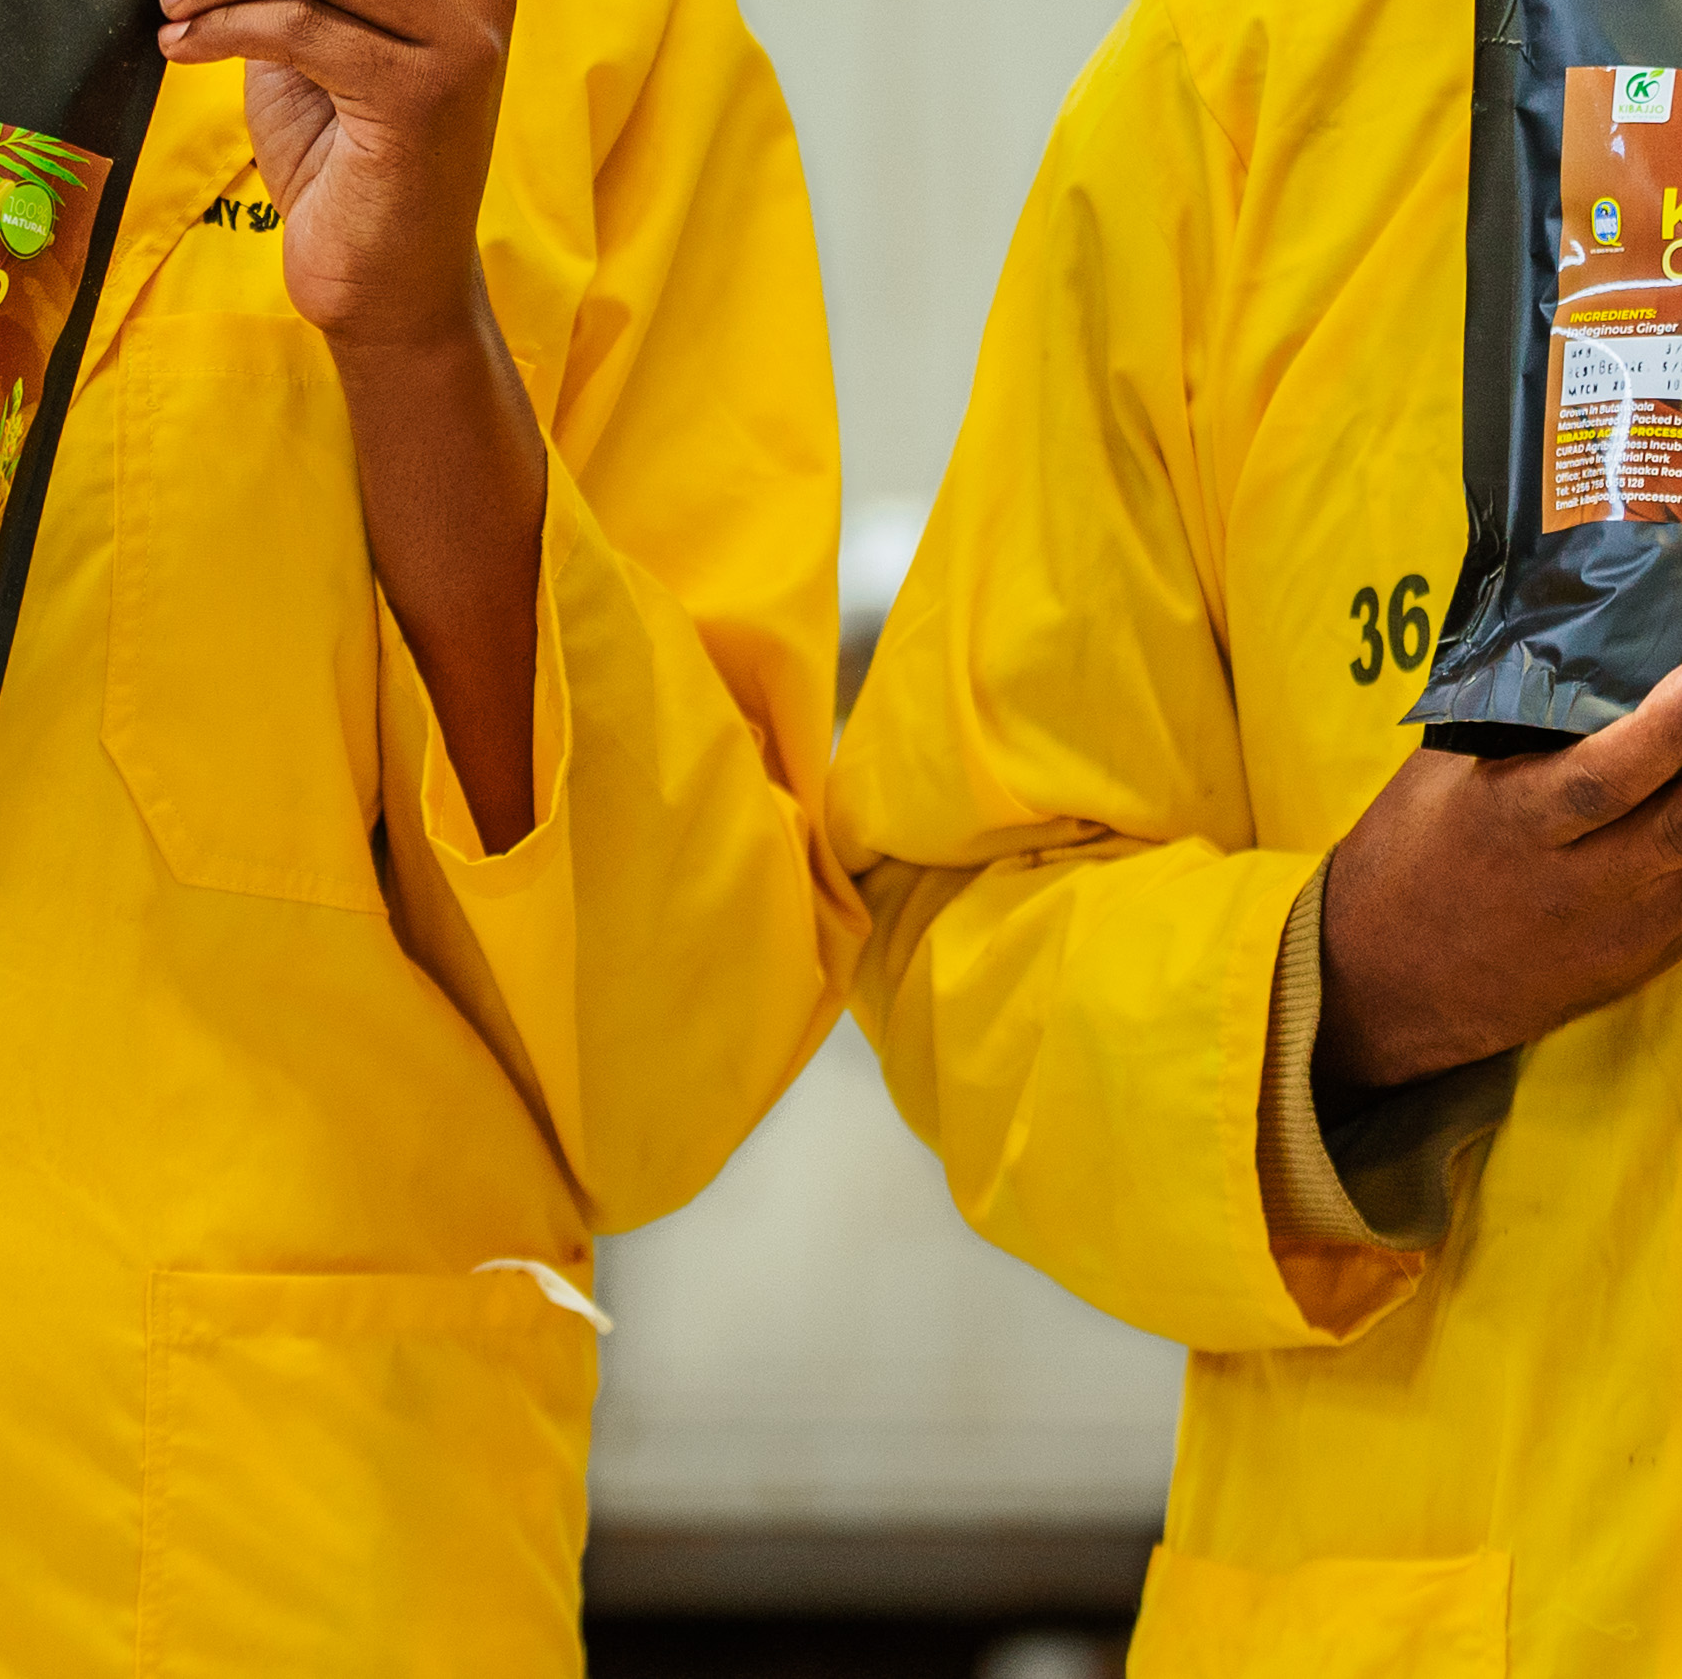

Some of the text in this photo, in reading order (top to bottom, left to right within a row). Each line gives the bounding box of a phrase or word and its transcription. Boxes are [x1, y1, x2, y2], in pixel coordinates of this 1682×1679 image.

[1618, 104, 1664, 115] KIBAJJO
[9, 196, 48, 224] 100%
[2, 213, 47, 236] NATURAL
[1570, 308, 1657, 323] INGREDIENTS:
[1636, 321, 1679, 335] Ginger
[1559, 402, 1654, 419] Grown in Butabala
[1632, 414, 1672, 426] Packed
[1557, 429, 1596, 444] KIBAJJO
[1555, 444, 1584, 457] CURAD
[1644, 453, 1671, 464] Park
[1627, 477, 1645, 489] 128
[1555, 498, 1579, 511] Email:
[1350, 574, 1430, 686] 36
